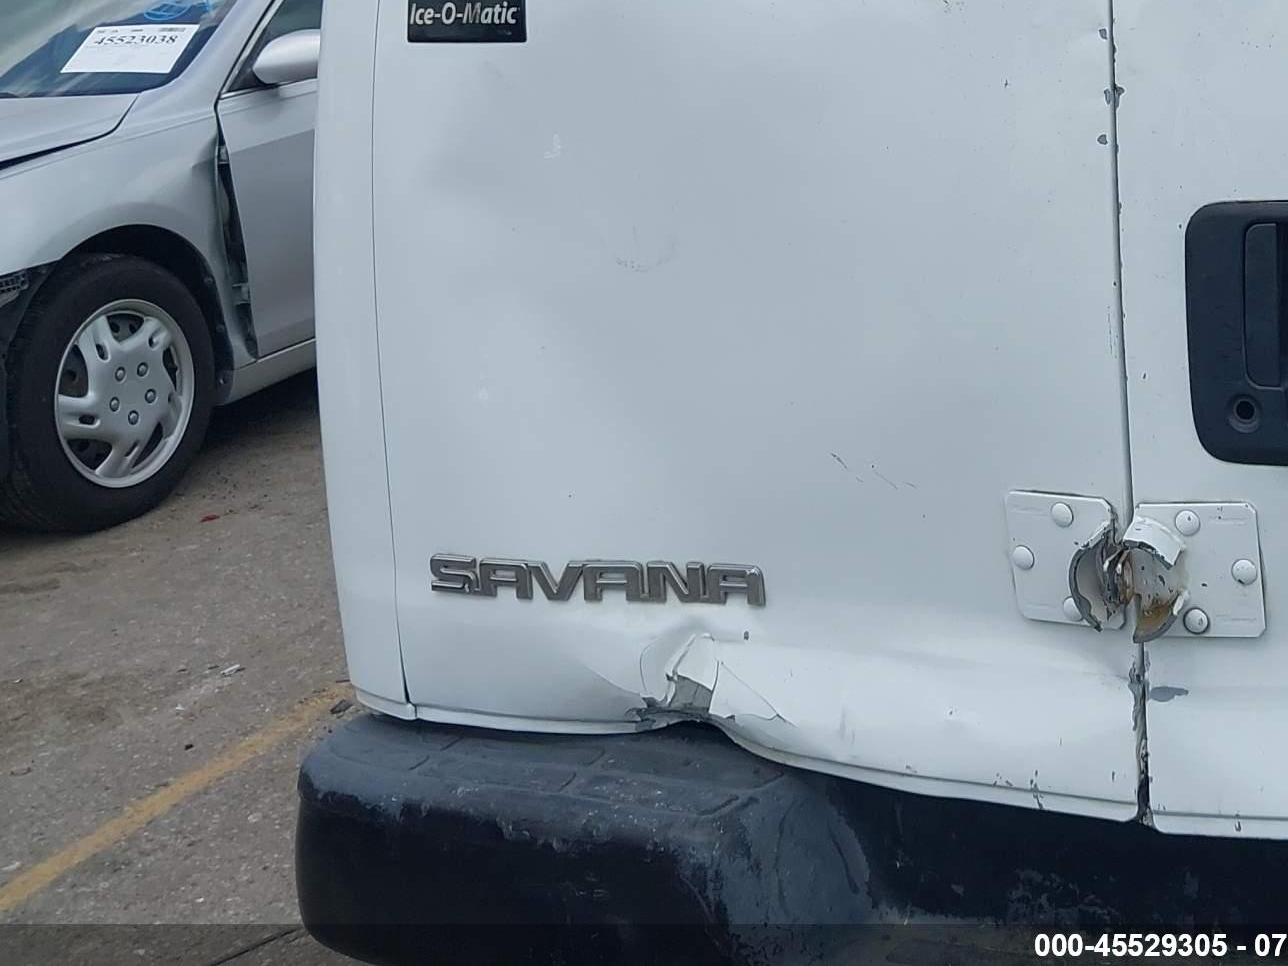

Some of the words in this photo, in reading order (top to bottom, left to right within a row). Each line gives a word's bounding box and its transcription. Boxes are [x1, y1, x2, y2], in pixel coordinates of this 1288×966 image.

[409, 1, 518, 25] Ice-O-Matic
[94, 34, 178, 45] 45523038
[430, 553, 766, 607] SAVANA
